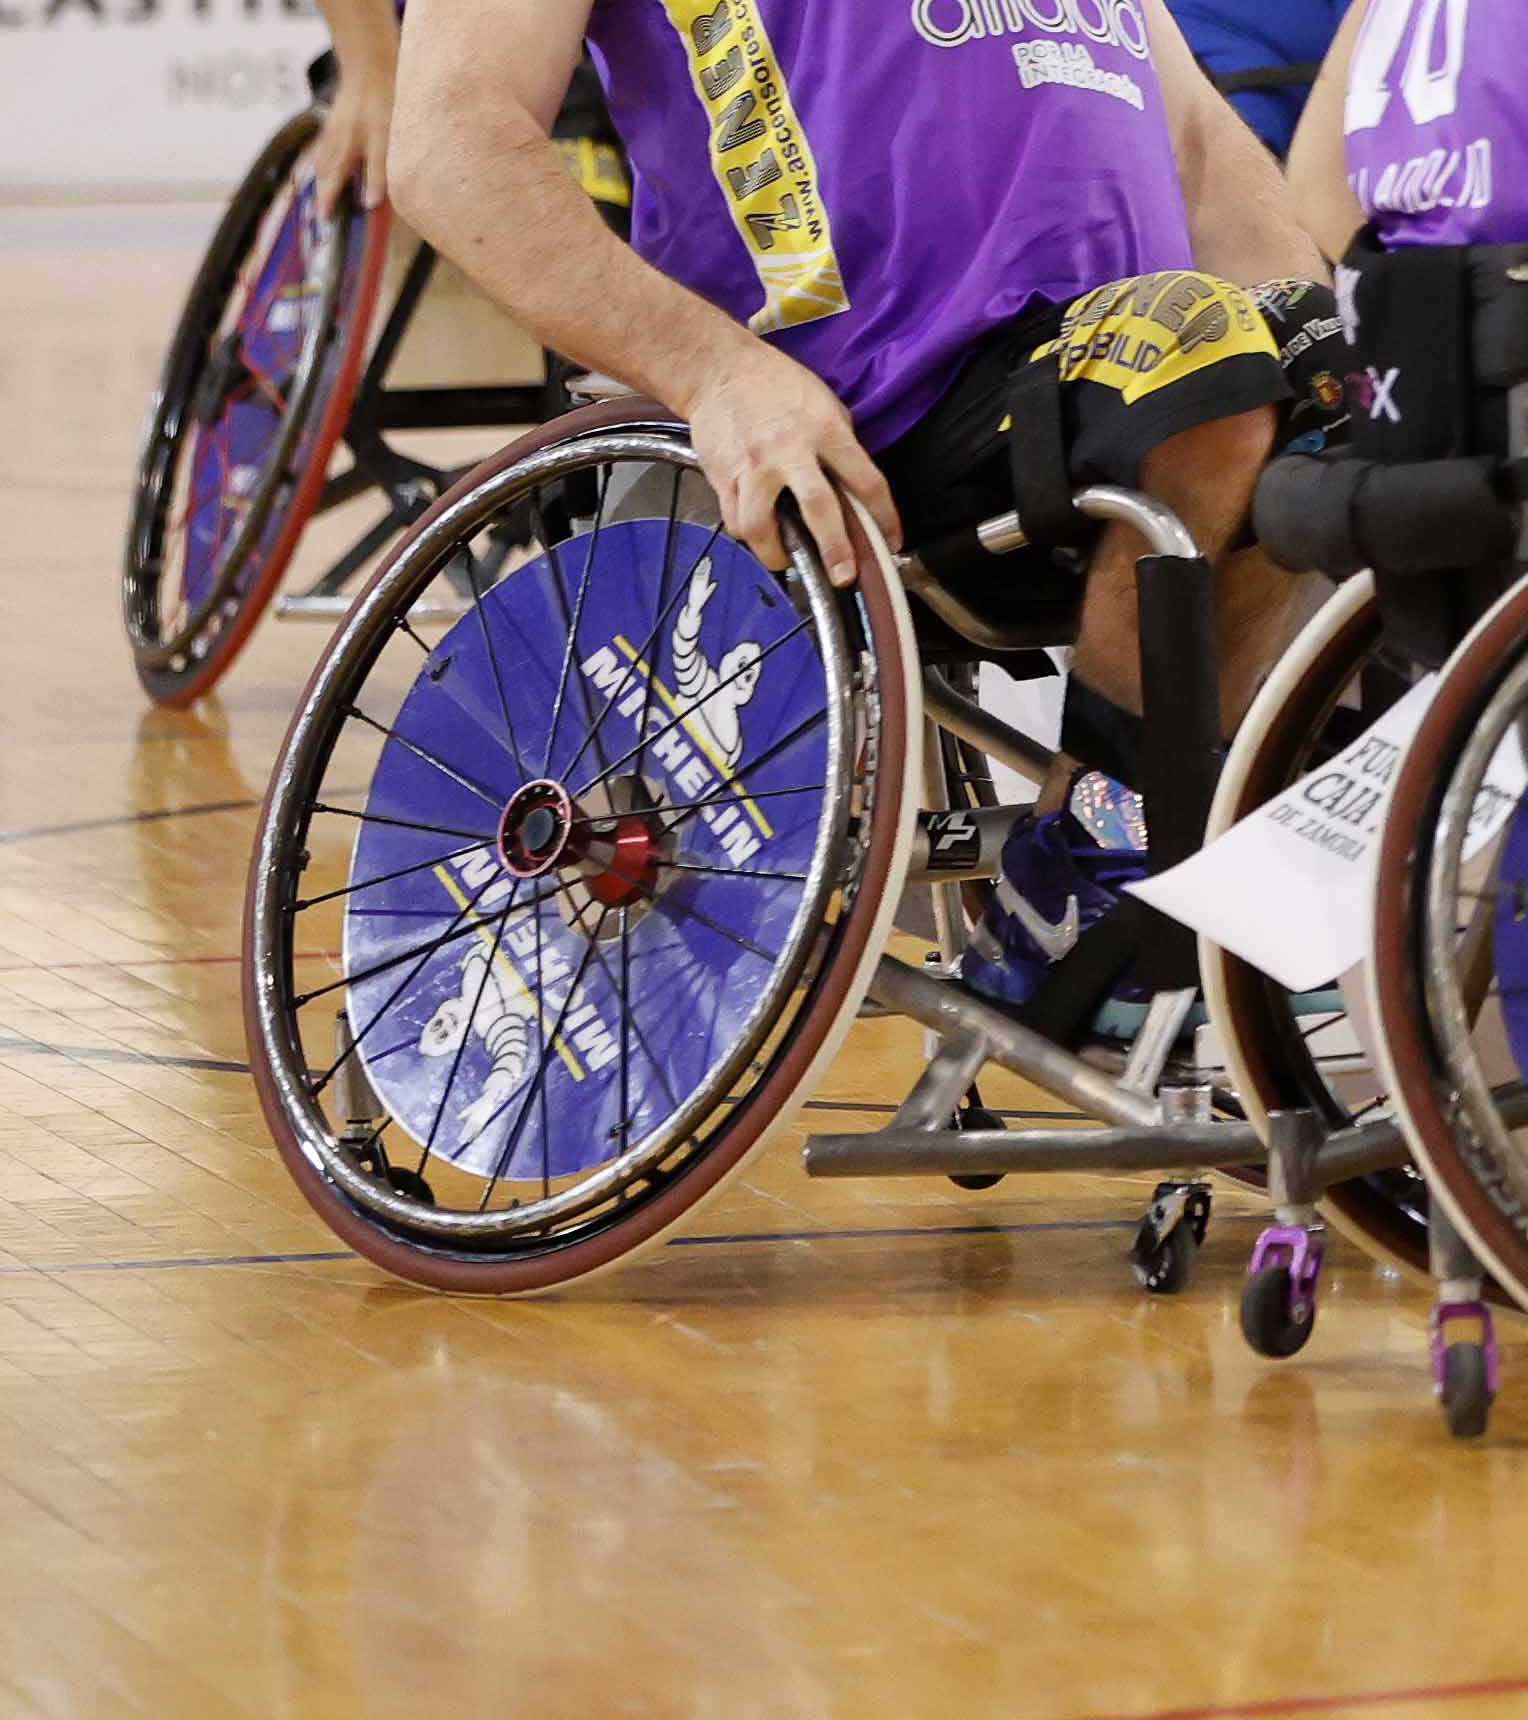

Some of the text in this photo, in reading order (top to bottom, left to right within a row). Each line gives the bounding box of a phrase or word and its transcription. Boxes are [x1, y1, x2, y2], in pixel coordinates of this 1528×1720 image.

[690, 0, 801, 250] ZENER
[580, 645, 763, 868] MICHELIN
[450, 842, 623, 1072] MICHELIN
